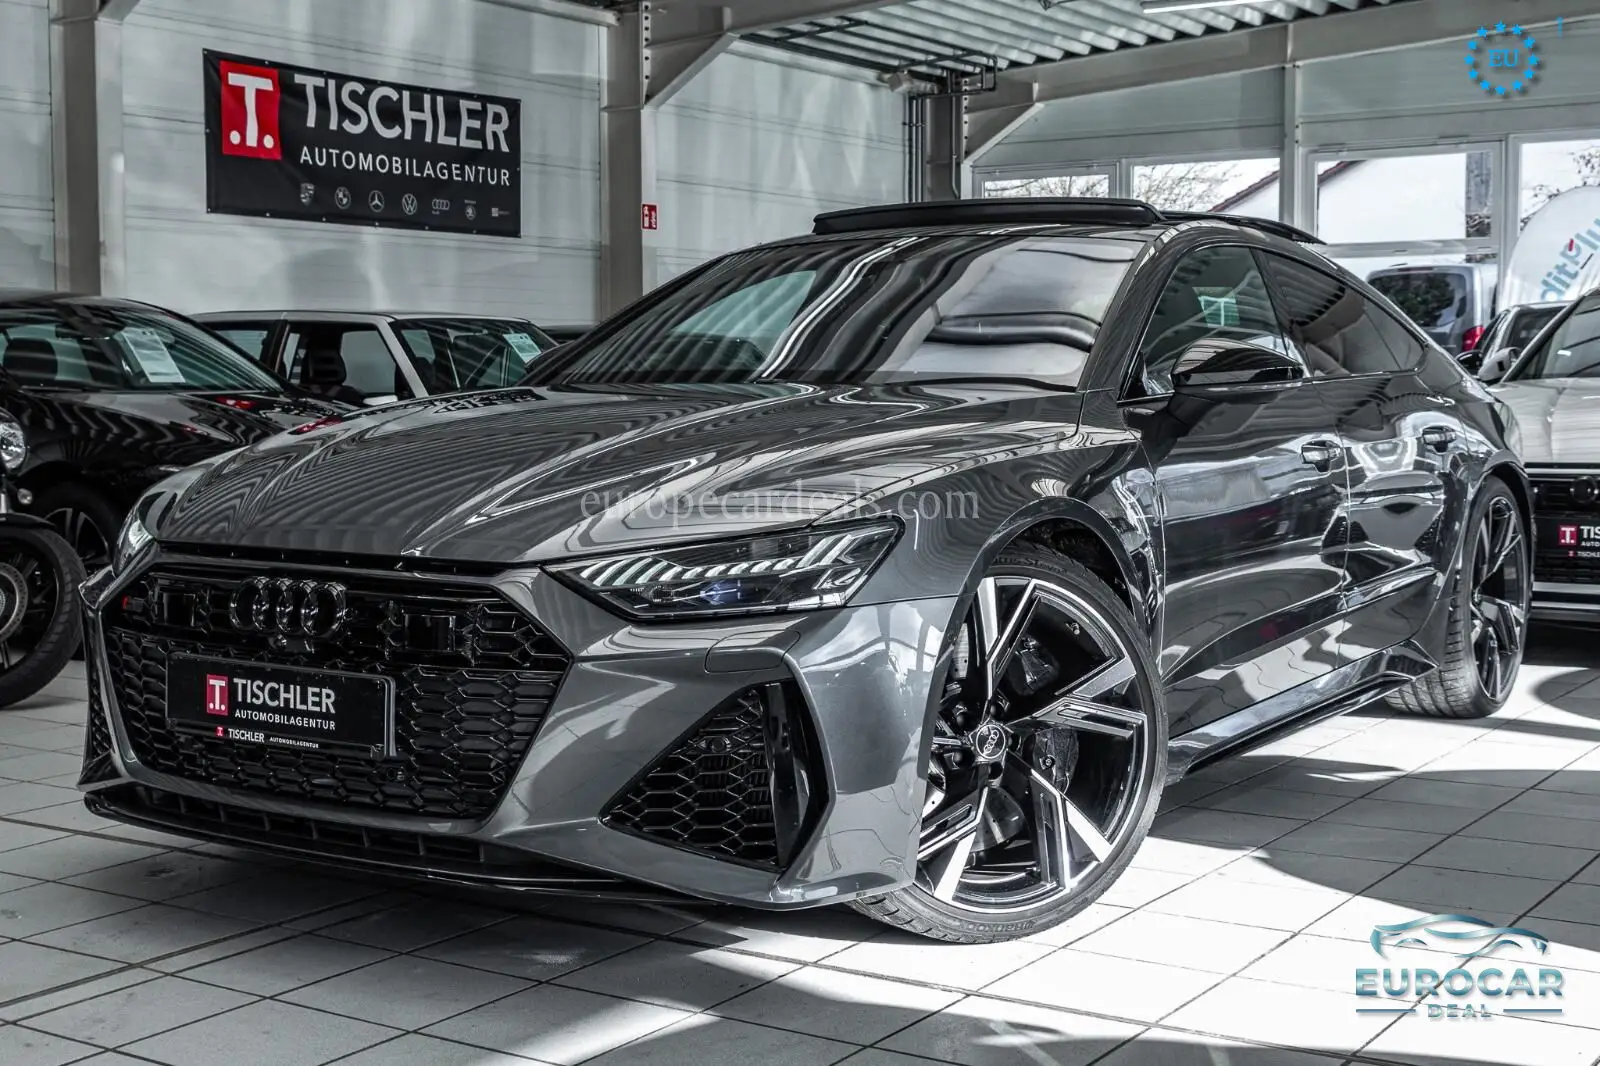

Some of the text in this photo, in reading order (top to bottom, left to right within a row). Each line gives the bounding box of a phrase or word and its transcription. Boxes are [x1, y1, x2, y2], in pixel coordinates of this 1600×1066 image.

[294, 73, 510, 153] TISCHLER
[300, 146, 510, 187] AUTOMOBILAGENTUR
[233, 677, 336, 714] TISCHLER
[228, 728, 265, 743] TISCHLER
[234, 709, 336, 731] AUTOMOBILAGENTUR
